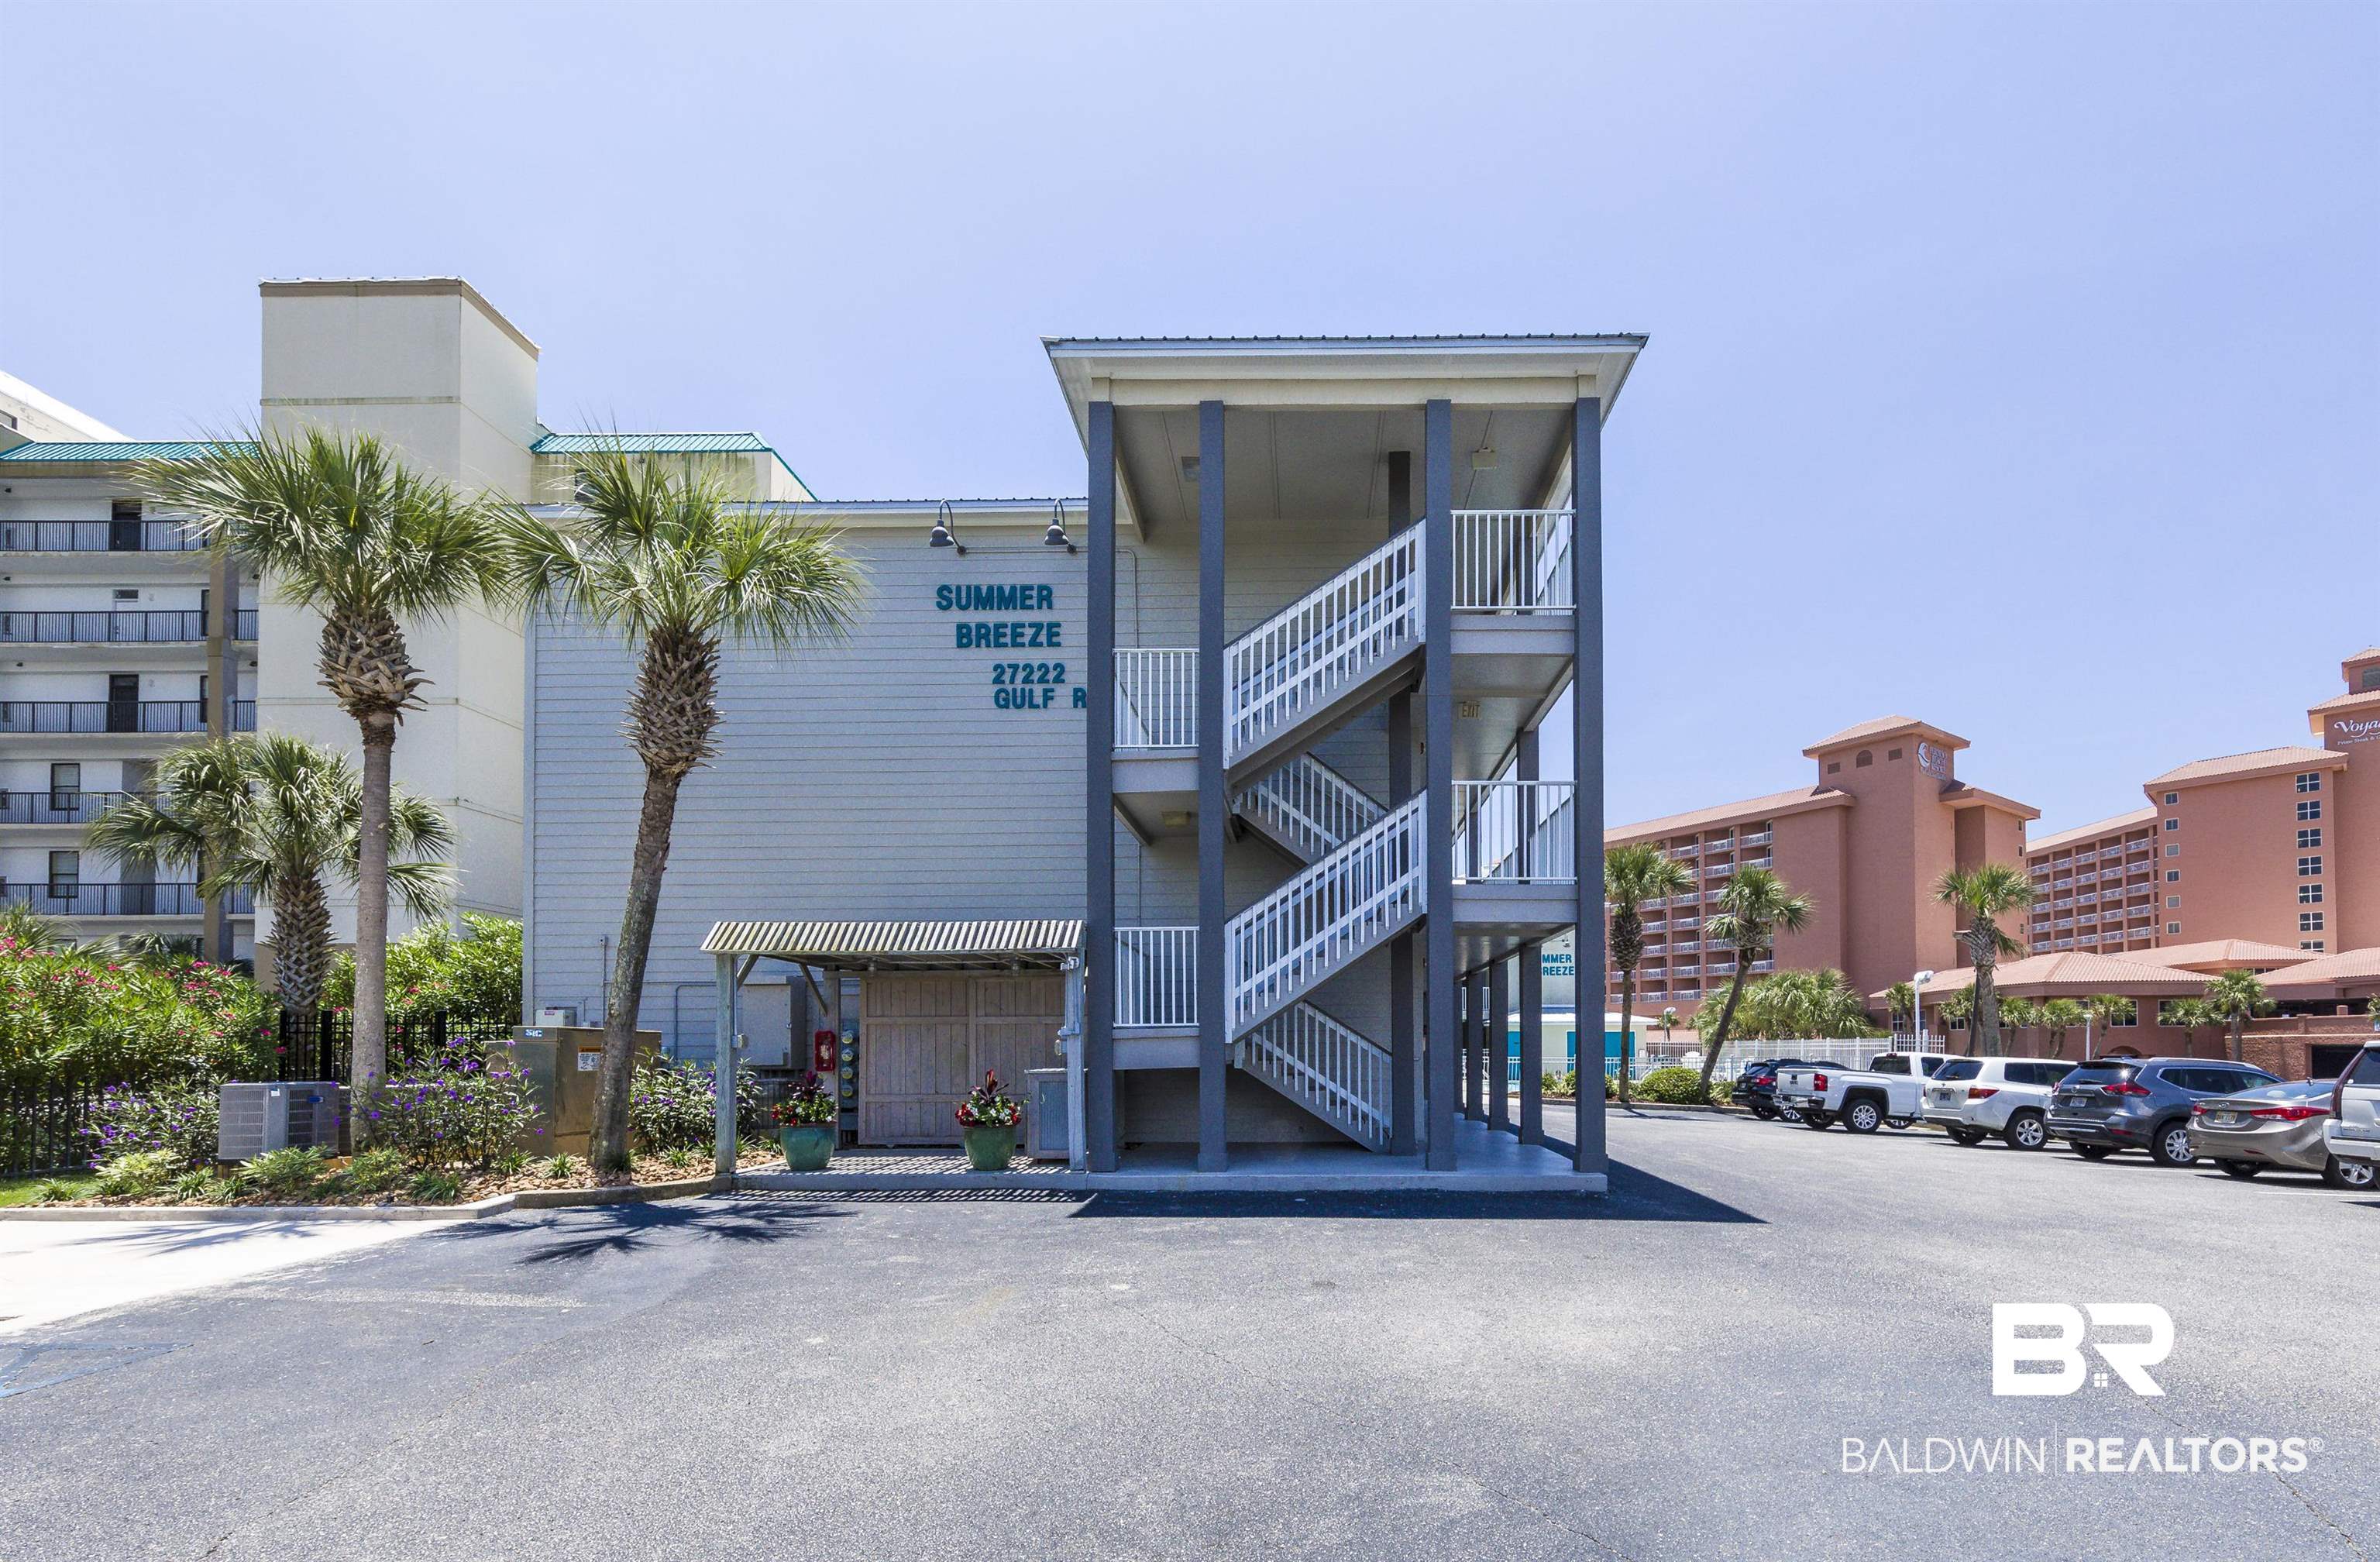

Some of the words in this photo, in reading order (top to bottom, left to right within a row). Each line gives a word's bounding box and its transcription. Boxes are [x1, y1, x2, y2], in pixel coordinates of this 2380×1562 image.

[936, 584, 1053, 611] SUMMER
[956, 622, 1061, 648] BREEZE
[992, 663, 1065, 684] 27222
[994, 687, 1055, 709] GULF
[1073, 687, 1088, 709] R
[1462, 704, 1481, 718] EXIT
[2334, 720, 2380, 738] Voya
[1542, 954, 1572, 963] MMER
[1543, 966, 1574, 975] REEZE
